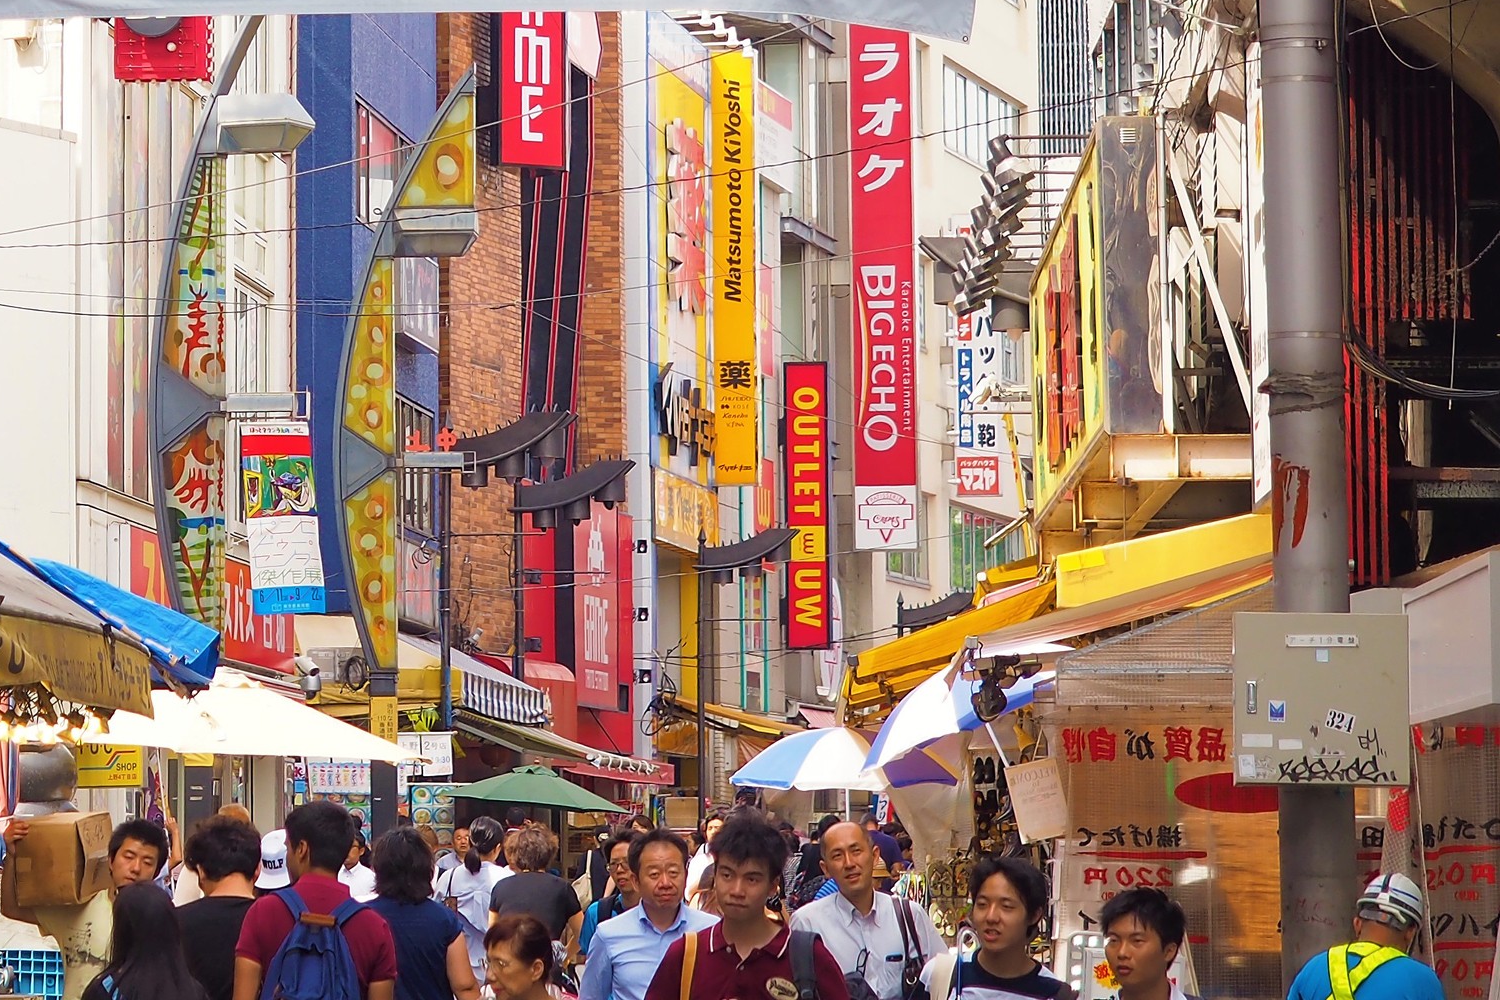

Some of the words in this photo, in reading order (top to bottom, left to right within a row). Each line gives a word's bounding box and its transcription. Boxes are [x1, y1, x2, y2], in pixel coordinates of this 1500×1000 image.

[857, 43, 904, 195] ラオケ
[724, 169, 741, 302] Matsumoto
[861, 265, 895, 336] BIG
[901, 281, 912, 332] Karaoke
[720, 361, 751, 390] 薬
[863, 344, 899, 452] ECHO
[901, 337, 912, 431] Entertainment
[793, 385, 821, 518] OUTLET
[960, 469, 998, 492] マスヤ
[1326, 710, 1355, 734] 324
[116, 762, 137, 771] SHOP
